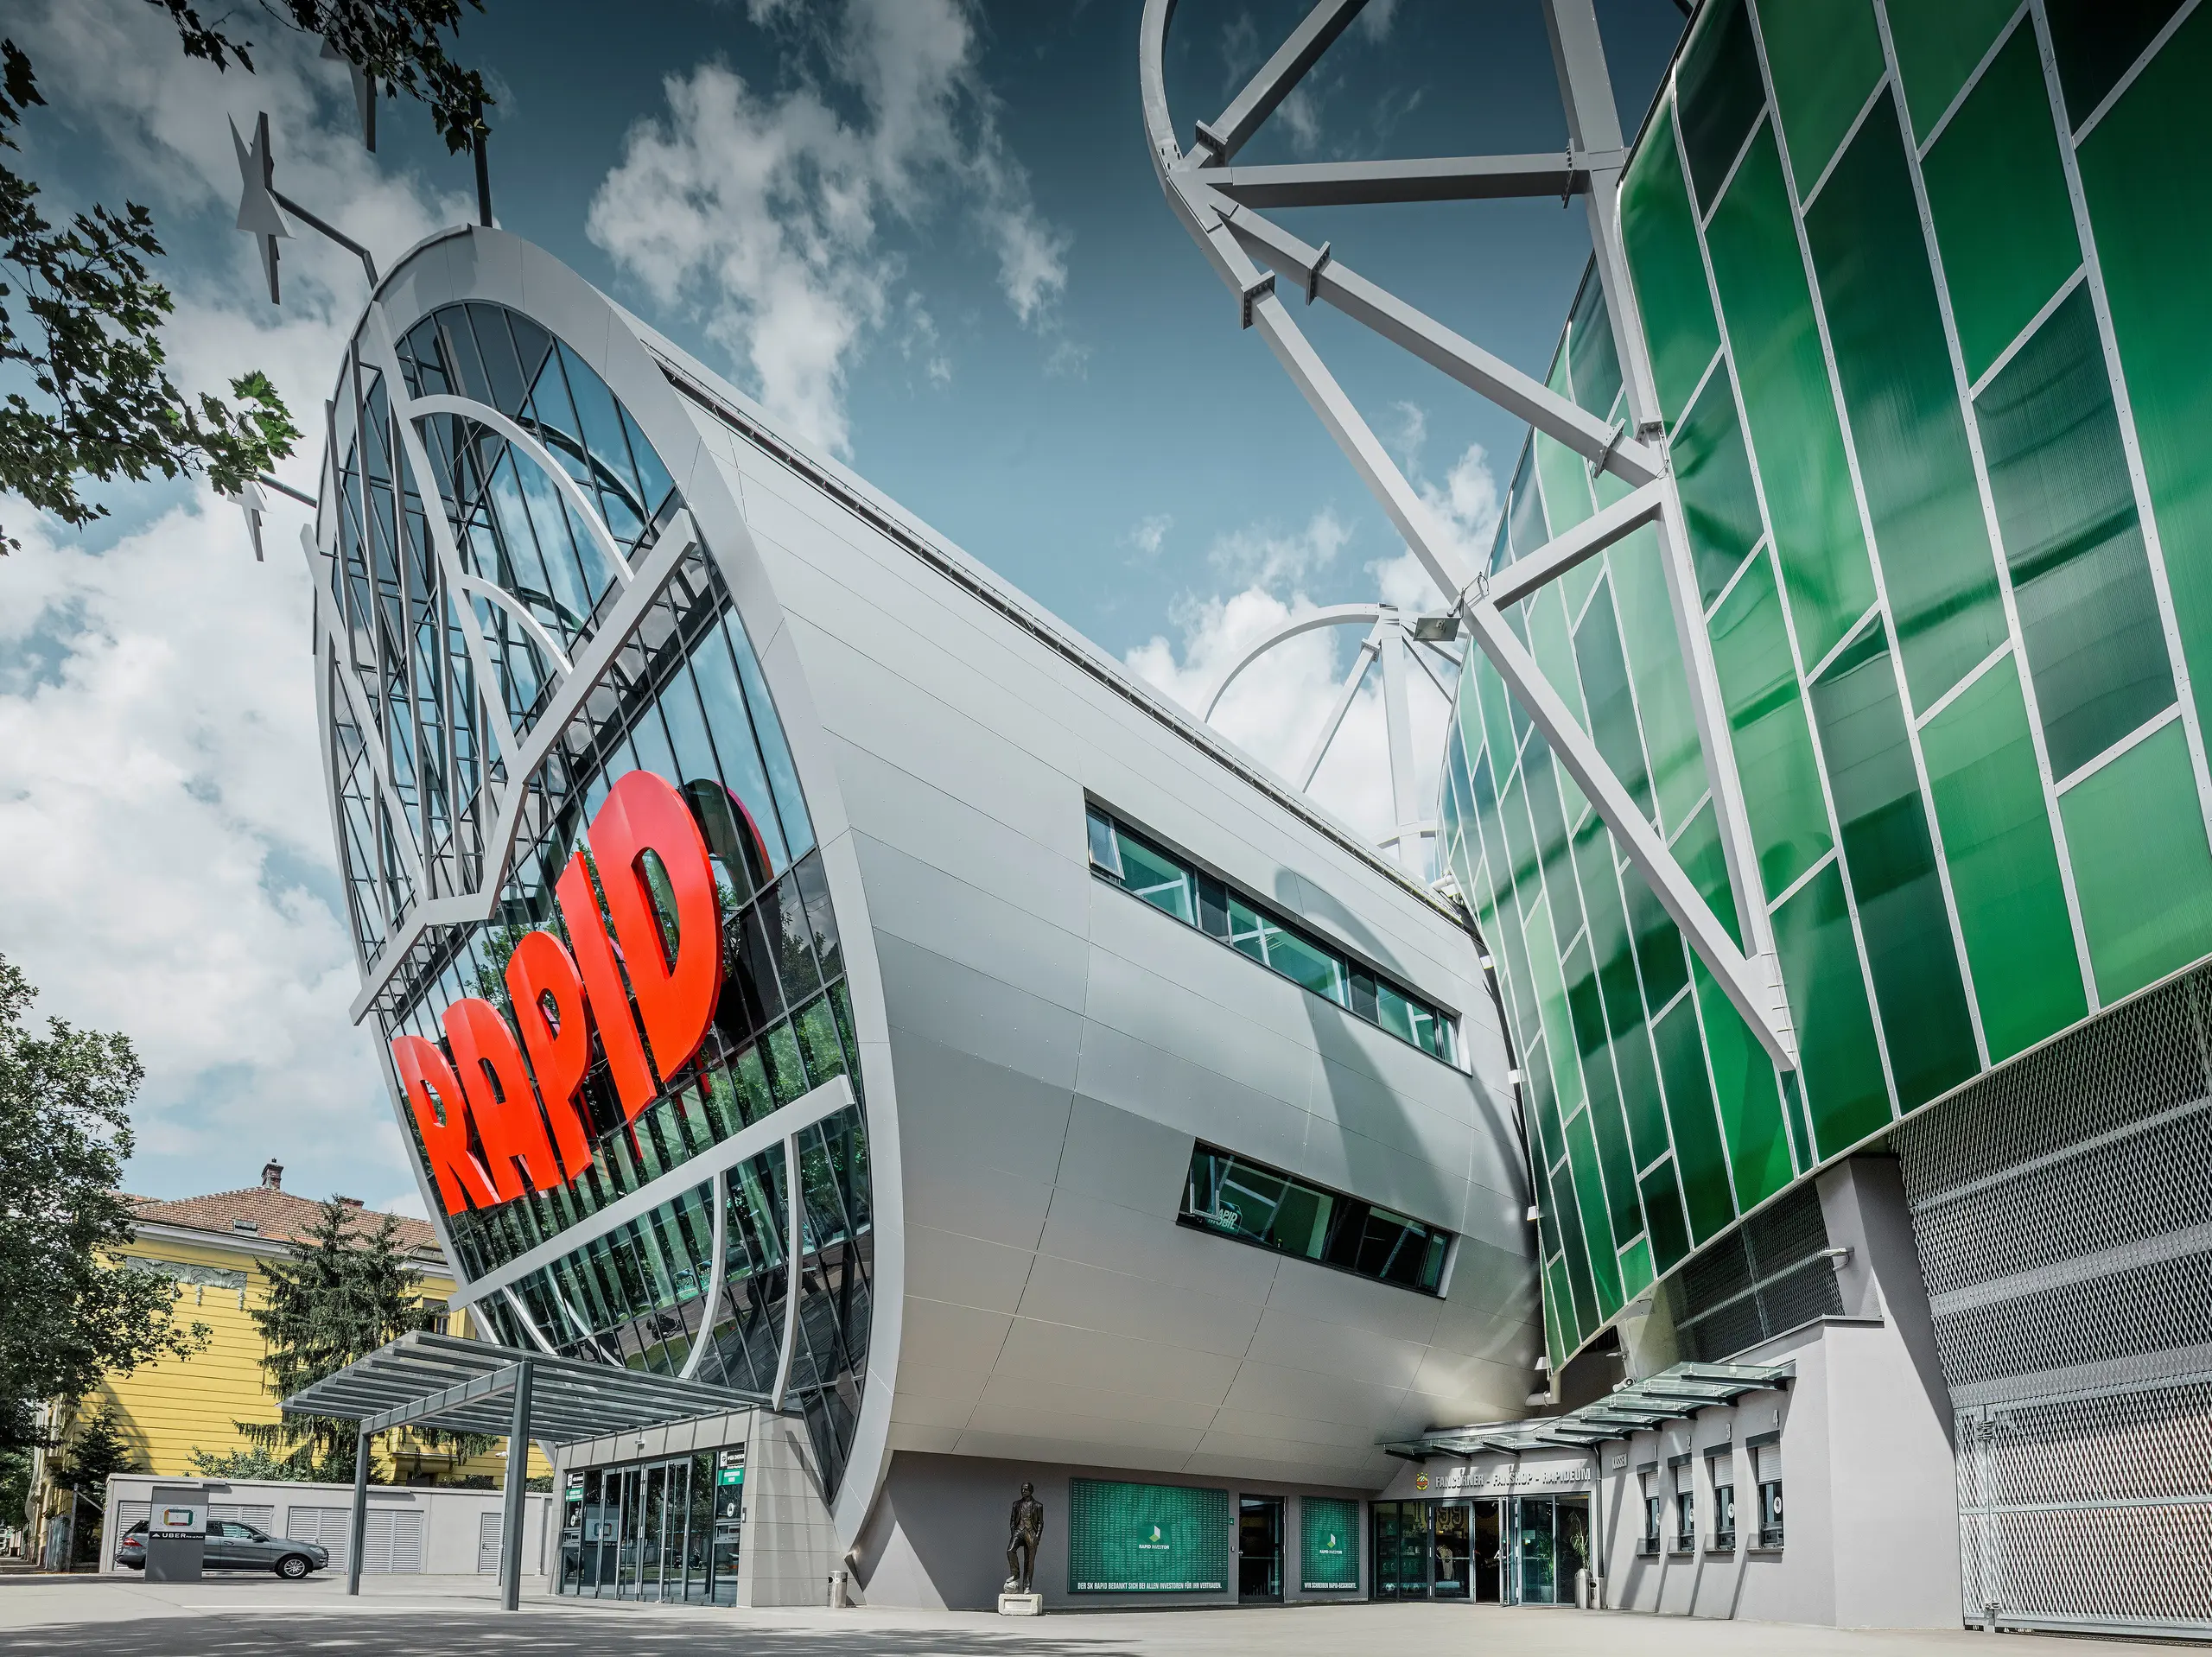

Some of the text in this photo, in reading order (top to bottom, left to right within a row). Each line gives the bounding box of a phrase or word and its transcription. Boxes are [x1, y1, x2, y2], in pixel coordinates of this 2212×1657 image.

[391, 769, 723, 1217] RAPID
[1218, 1209, 1238, 1222] APID
[1773, 1409, 1780, 1426] 4
[1726, 1423, 1732, 1439] 3
[1687, 1435, 1692, 1451] 2
[1435, 1473, 1484, 1489] FANCORNER
[1493, 1470, 1532, 1487] FANSHOP
[1542, 1468, 1591, 1485] RAPIDEUM
